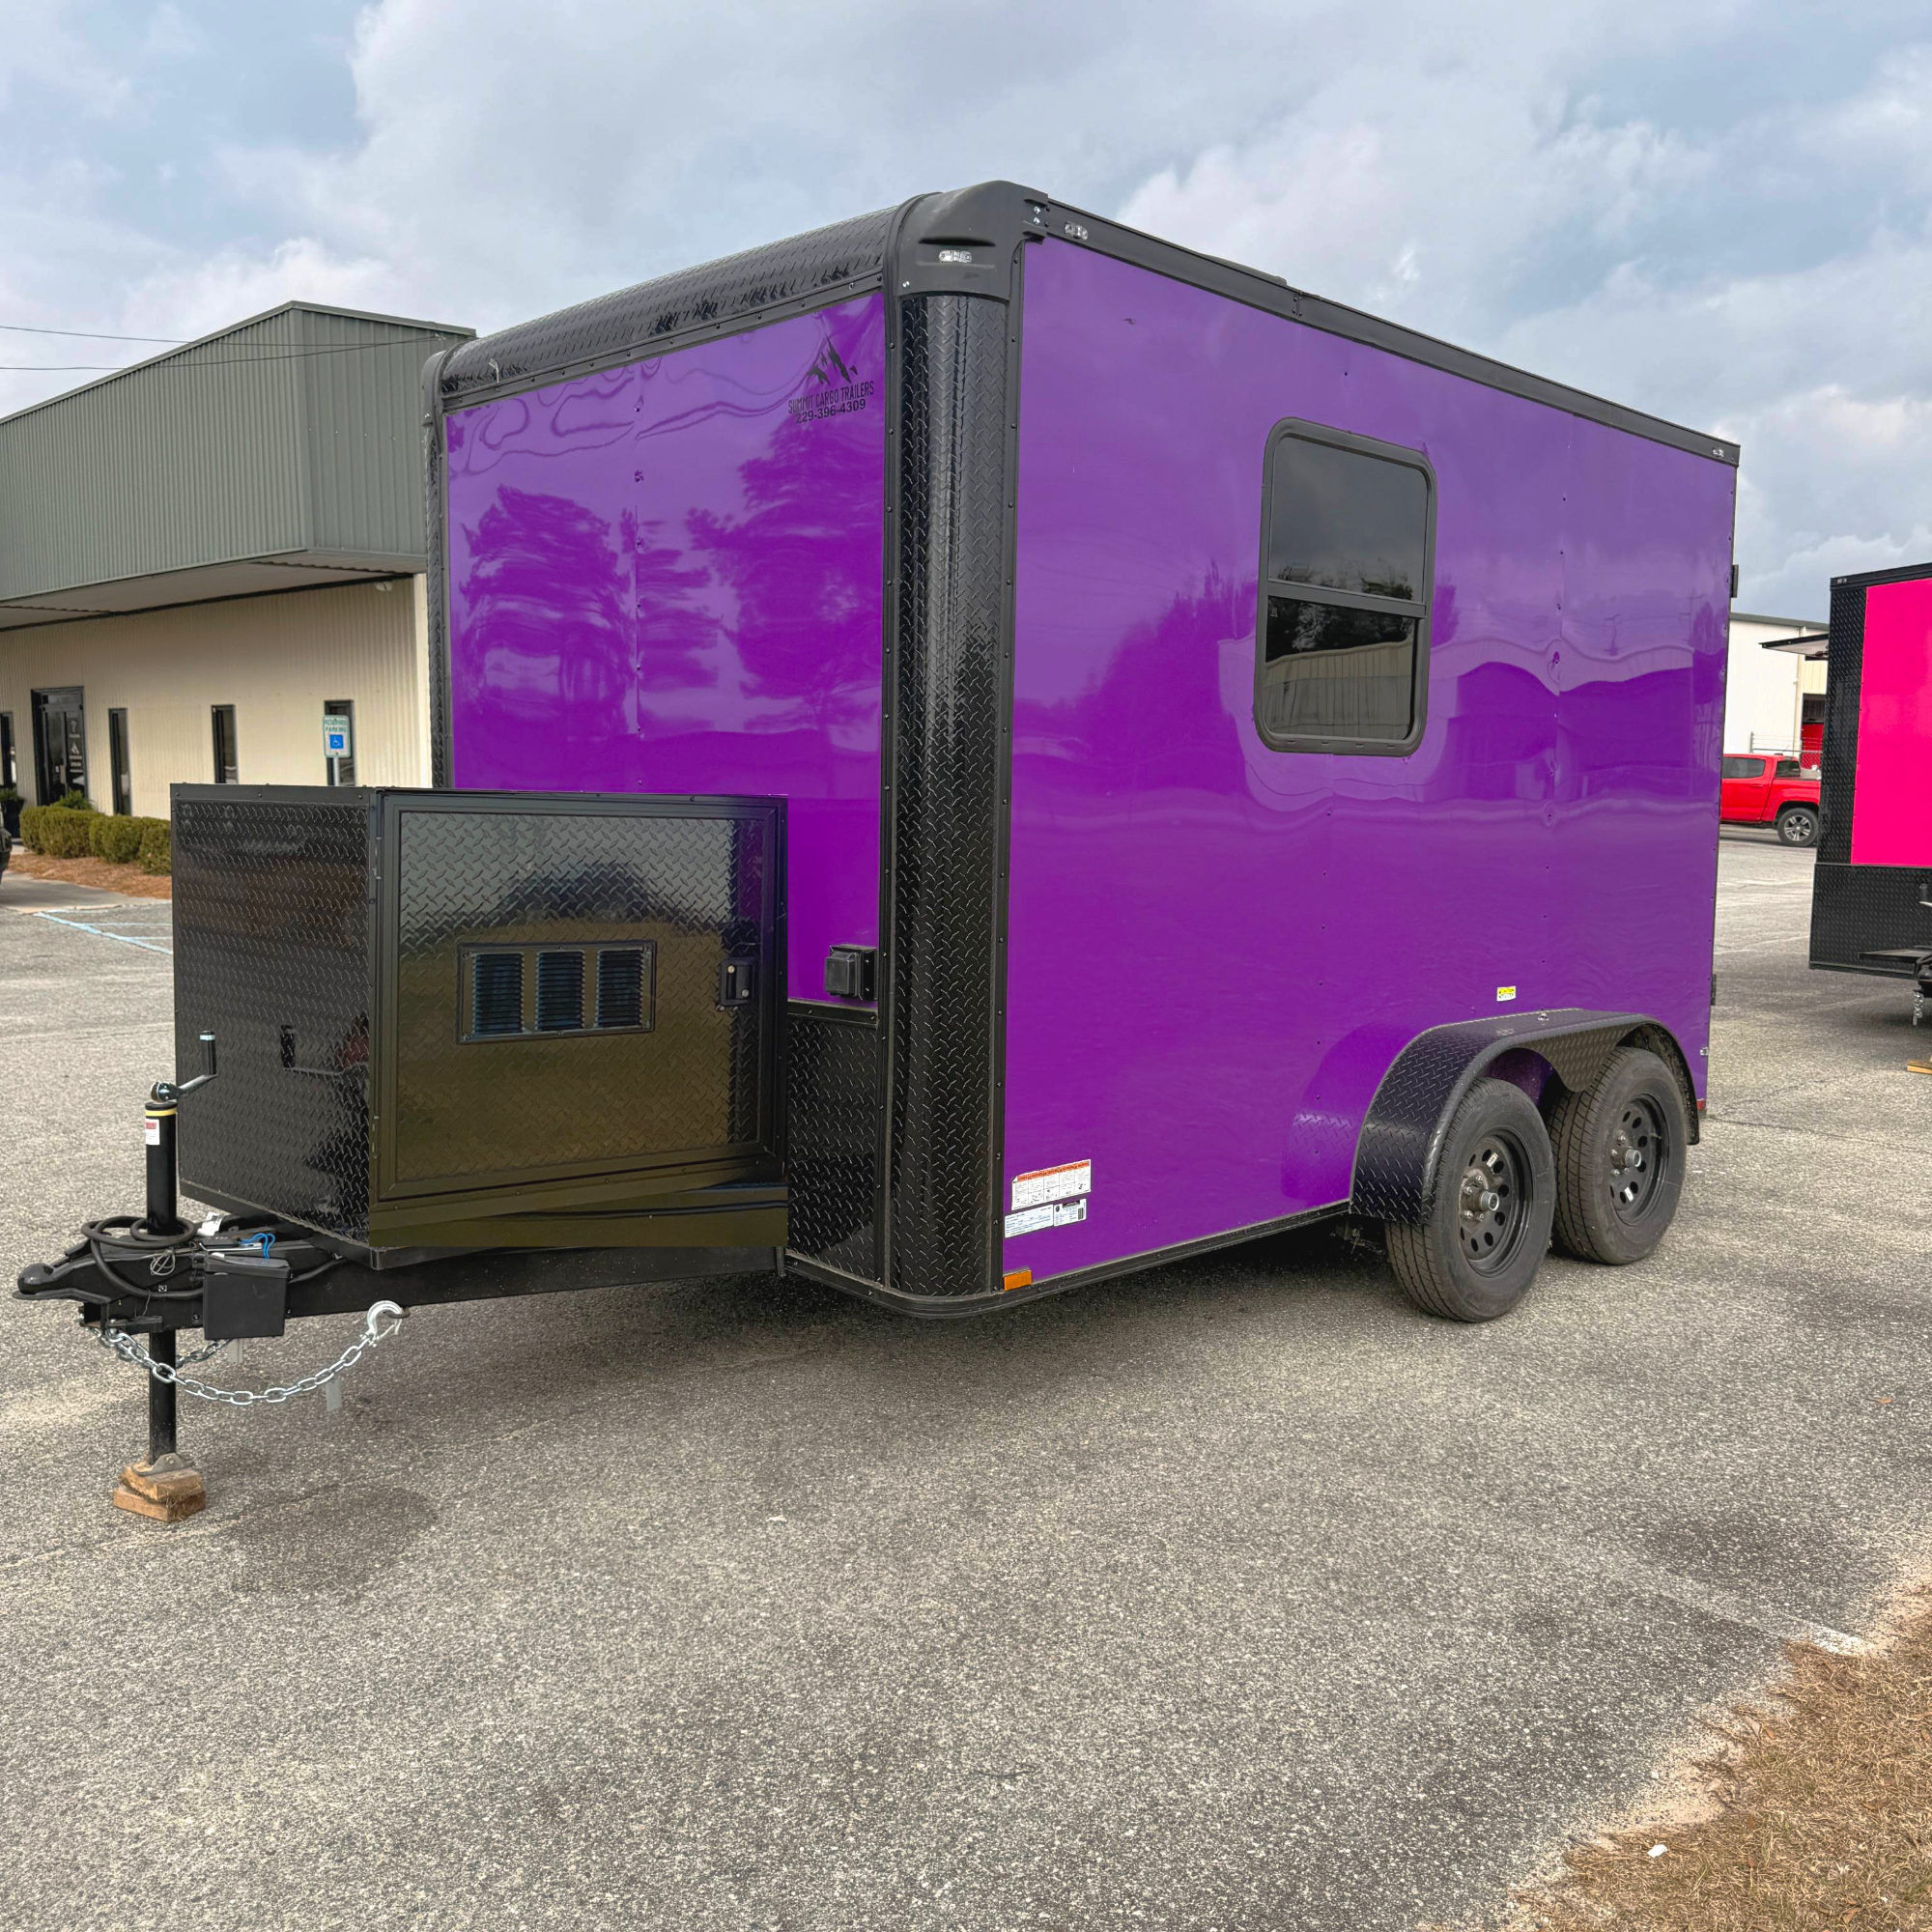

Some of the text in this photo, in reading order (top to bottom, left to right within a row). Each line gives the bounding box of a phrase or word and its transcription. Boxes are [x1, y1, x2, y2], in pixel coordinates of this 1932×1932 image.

[788, 381, 874, 414] SUMMIT CARGO TRAILERS
[796, 398, 867, 424] 229-396-4309
